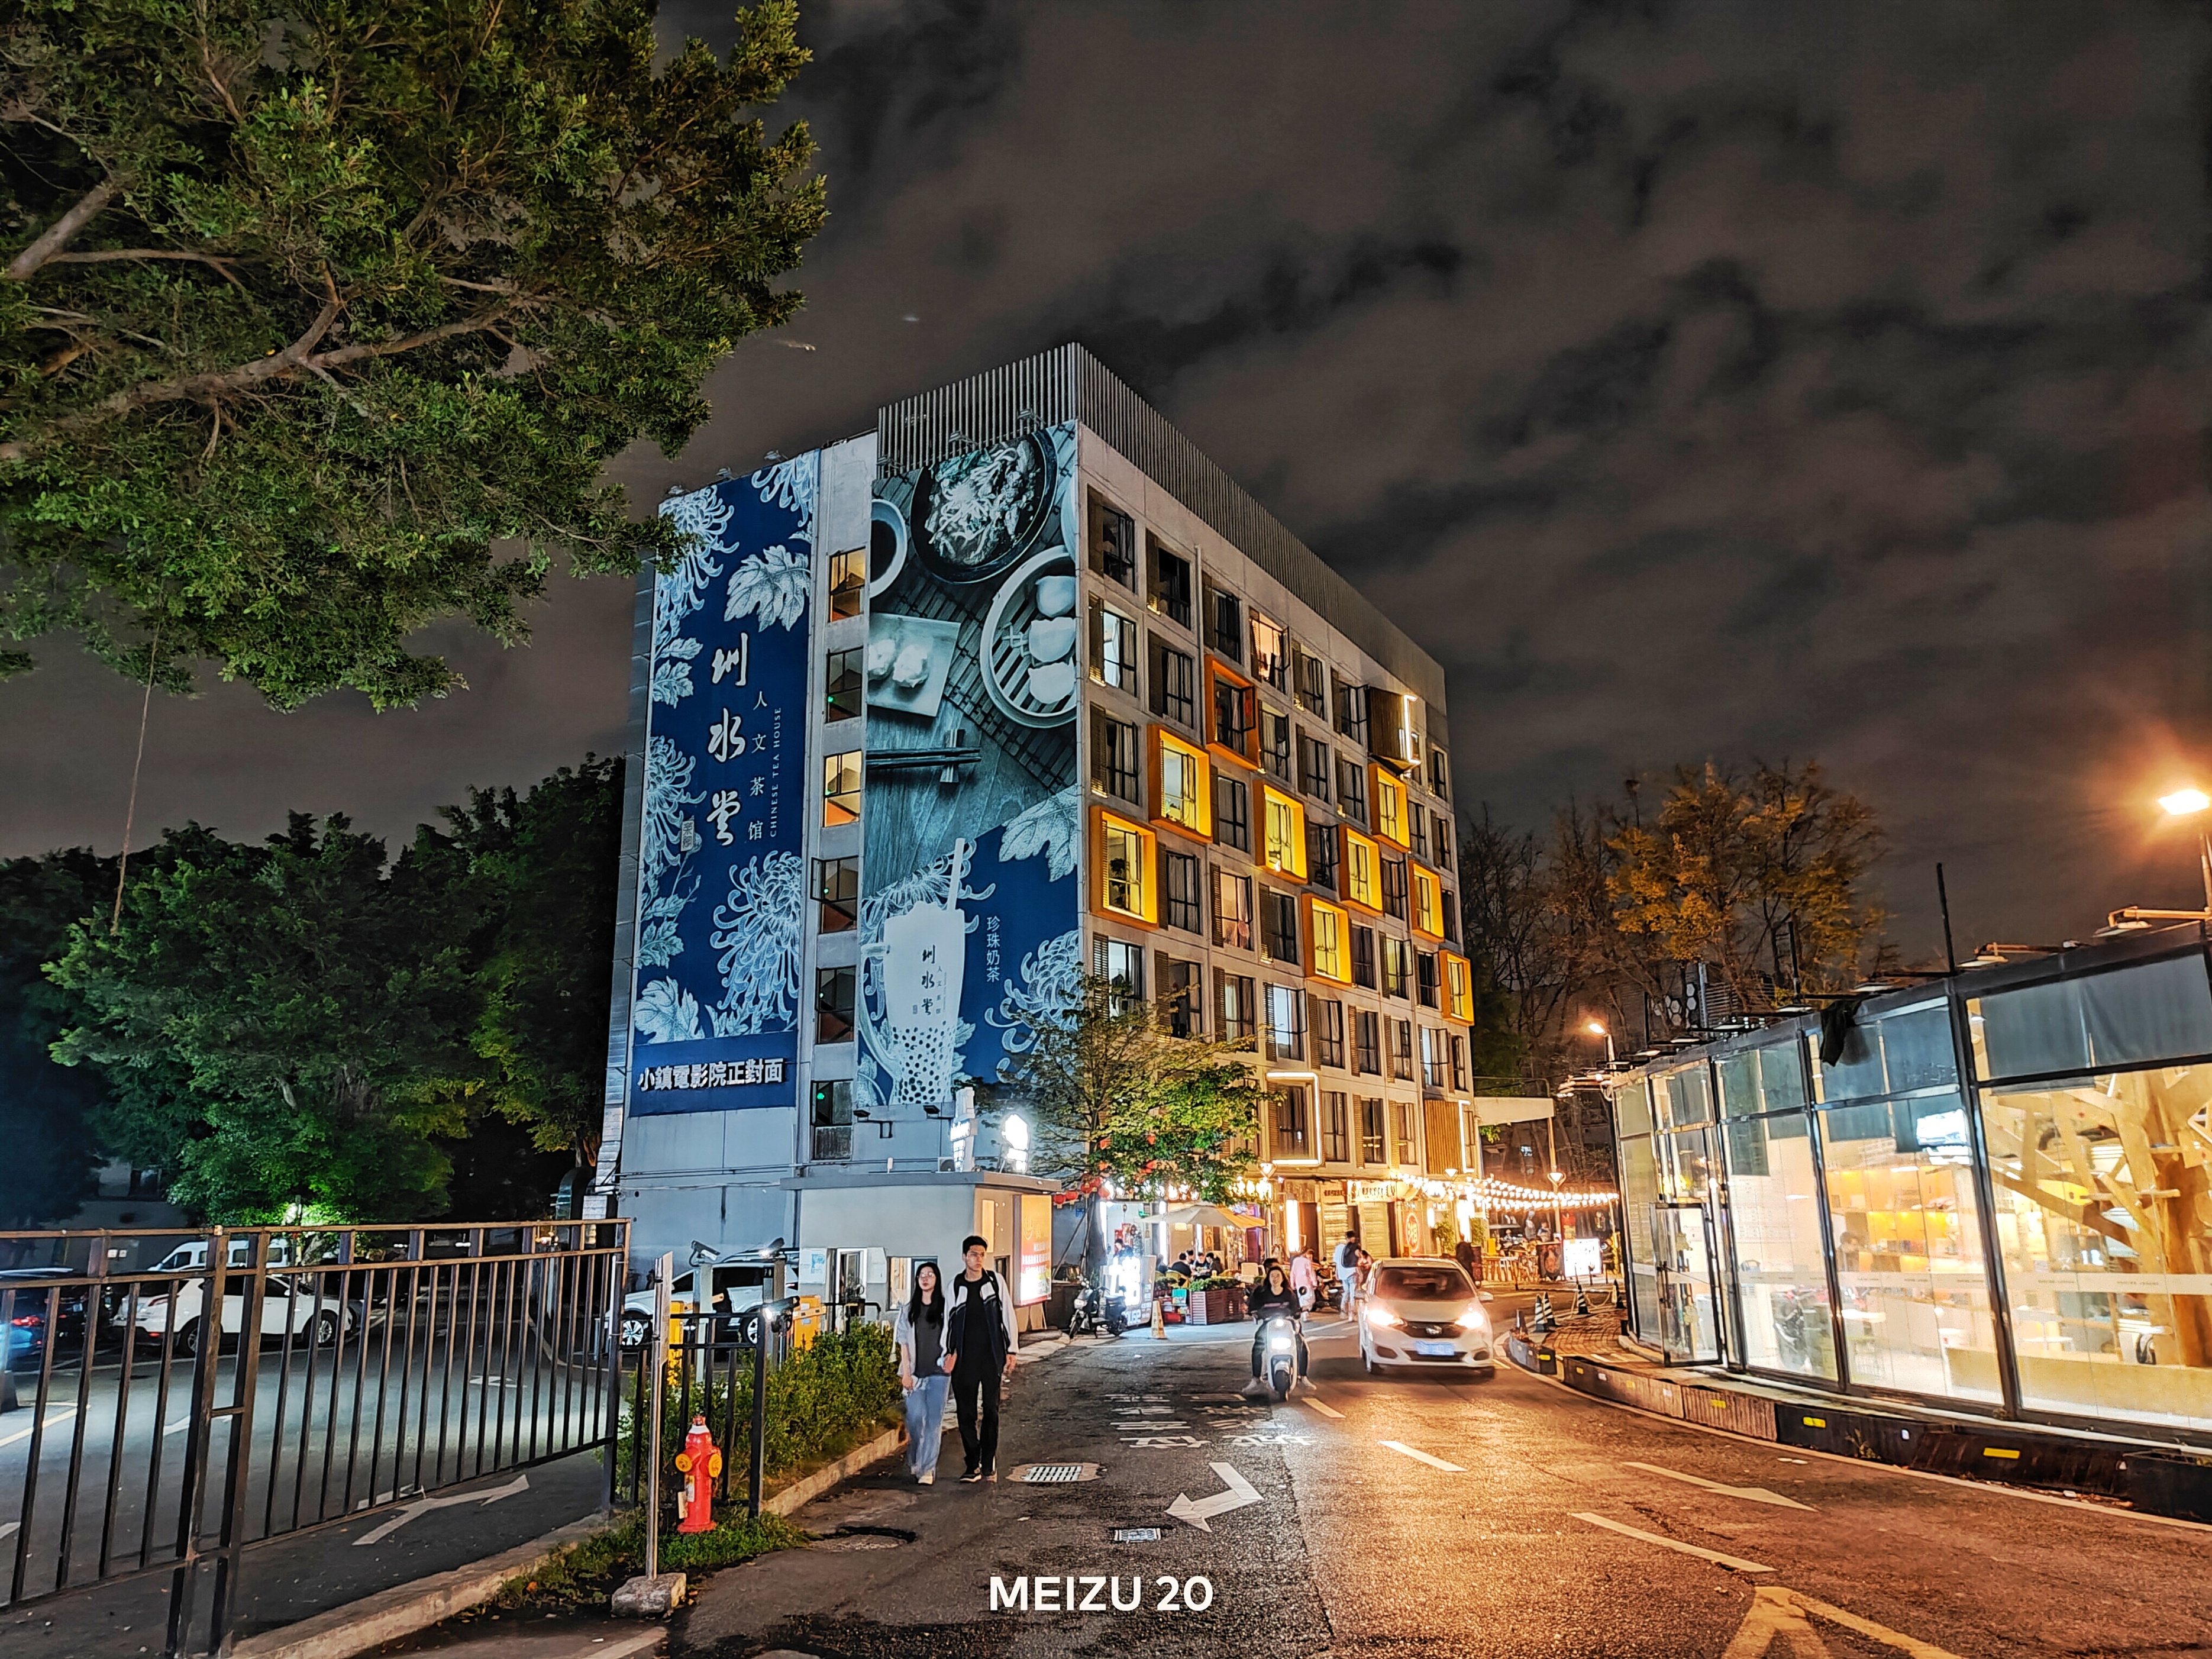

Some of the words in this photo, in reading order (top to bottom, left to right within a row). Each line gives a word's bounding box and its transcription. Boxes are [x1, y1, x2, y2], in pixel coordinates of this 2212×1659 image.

[773, 707, 782, 748] HOUSE
[748, 690, 768, 841] 人文茶馆
[770, 784, 779, 837] CHINESE
[986, 915, 1000, 983] 珍珠奶茶
[637, 1058, 784, 1092] 小鎮電影院正對面
